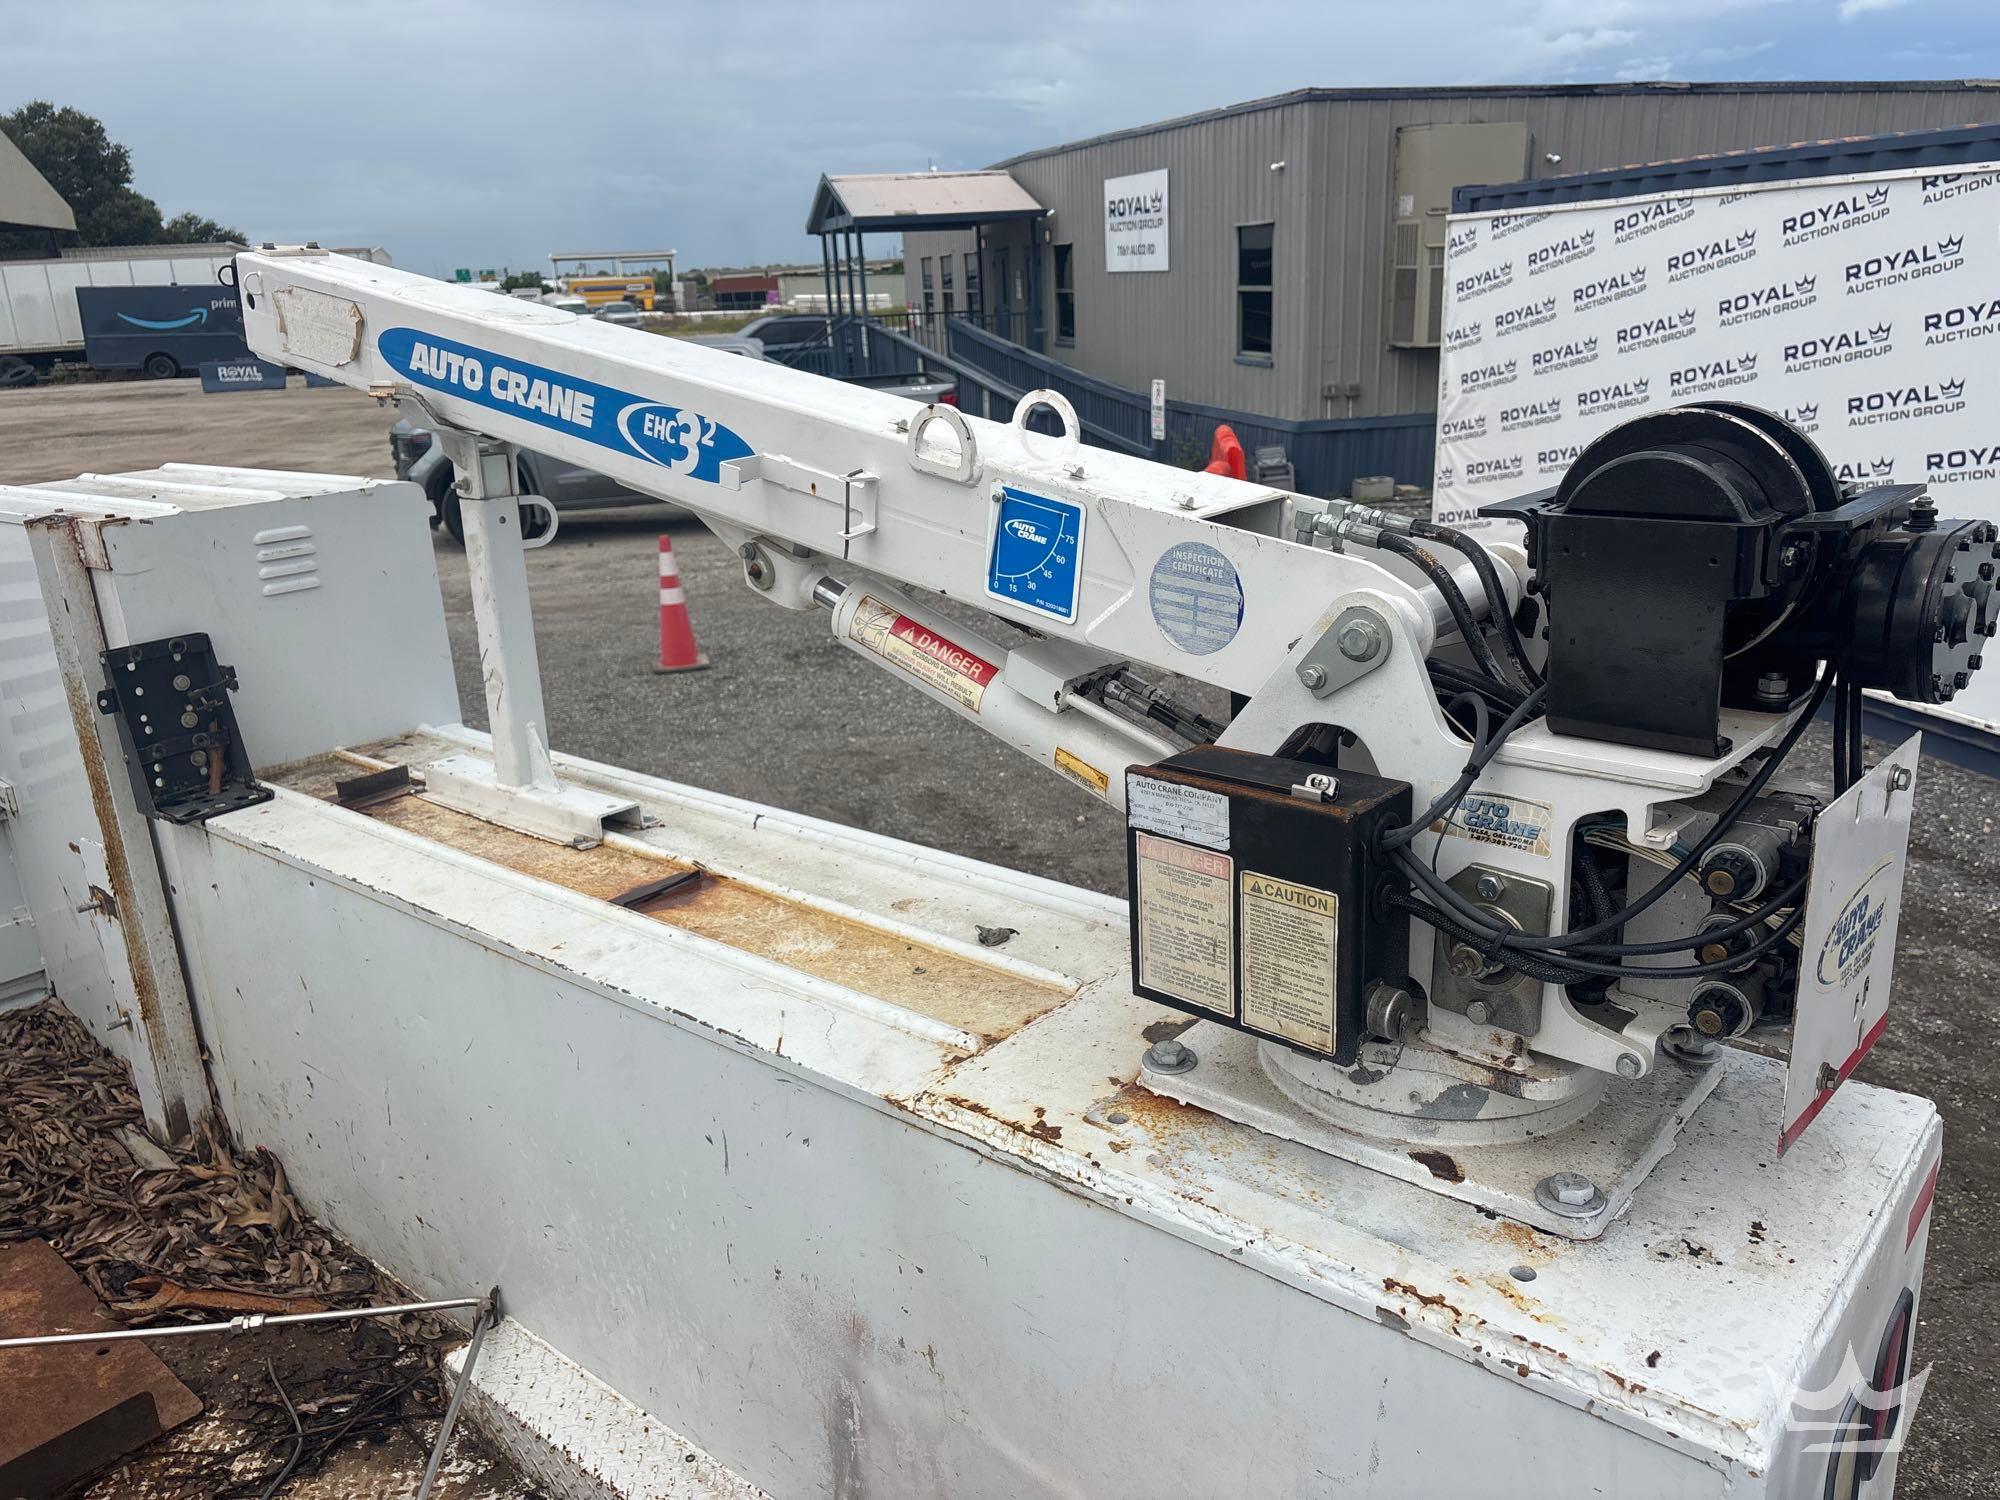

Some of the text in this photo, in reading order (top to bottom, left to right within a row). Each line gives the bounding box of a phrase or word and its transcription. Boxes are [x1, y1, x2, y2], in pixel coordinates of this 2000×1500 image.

[1922, 175, 1993, 206] AUCTION
[1108, 194, 1150, 218] ROYAL
[1614, 200, 1676, 235] ROYAL
[1782, 195, 1865, 235] ROYAL
[1109, 217, 1164, 232] AUCTION GROUP
[1614, 209, 1695, 245] AUCTION GROUP
[1783, 207, 1890, 248] AUCTION GROUP
[1528, 238, 1580, 267] ROYAL
[1528, 246, 1595, 276] AUCTION GROUP
[1667, 232, 1736, 273] ROYAL
[1668, 248, 1756, 284] AUCTION GROUP
[1845, 245, 1937, 282] ROYAL
[1456, 267, 1498, 294] ROYAL
[1573, 274, 1630, 303] ROYAL
[1846, 257, 1965, 296] AUCTION GROUP
[1573, 283, 1647, 313] AUCTION GROUP
[1718, 283, 1795, 316] ROYAL
[1719, 295, 1817, 328] AUCTION GROUP
[1494, 303, 1543, 328] ROYAL
[1496, 312, 1557, 337] AUCTION GROUP
[1617, 313, 1678, 344] ROYAL
[1924, 299, 2000, 332] ROYA
[1617, 326, 1696, 355] AUCTION GROUP
[1784, 330, 1868, 362] ROYAL
[1925, 323, 1994, 346] AUCTION
[1532, 342, 1584, 367] ROYAL
[1533, 352, 1599, 377] AUCTION GROUP
[1784, 344, 1892, 374] AUCTION GROUP
[409, 341, 596, 429] AUTO CRANE
[1670, 358, 1737, 387] ROYAL
[1671, 372, 1758, 398] AUCTION GROUP
[1577, 382, 1633, 407] ROYAL
[1578, 393, 1650, 417] AUCTION GROUP
[1848, 386, 1938, 414] ROYAL
[1442, 418, 1474, 435] OYAL
[1500, 402, 1548, 424] ROYAL
[1501, 412, 1562, 433] AUCTION GROUP
[1849, 400, 1966, 427] AUCTION GROUP
[643, 413, 676, 444] EHC
[1926, 446, 2000, 470] ROYA
[1927, 468, 1995, 484] AUCTION
[1012, 521, 1036, 534] AUTO
[1017, 530, 1048, 545] CRANE
[1065, 535, 1075, 545] 75
[1056, 555, 1066, 565] 60
[1172, 561, 1223, 579] CERTIFICATE
[1173, 550, 1225, 567] INSPECTION
[993, 580, 999, 589] 0
[1027, 581, 1037, 591] 30
[1043, 569, 1053, 579] 45
[1008, 583, 1018, 593] 15
[911, 649, 959, 679] SCISSORS POINT
[917, 633, 984, 679] DANGER
[936, 671, 951, 685] WILL
[950, 680, 973, 697] RESULT
[1136, 780, 1157, 791] AUTO
[1157, 784, 1182, 797] CRANE
[1183, 790, 1223, 804] COMPANY
[1463, 812, 1542, 840] CRANE
[1468, 827, 1535, 846] TULSA, OKLAHOMA
[1264, 883, 1328, 912] CAUTION
